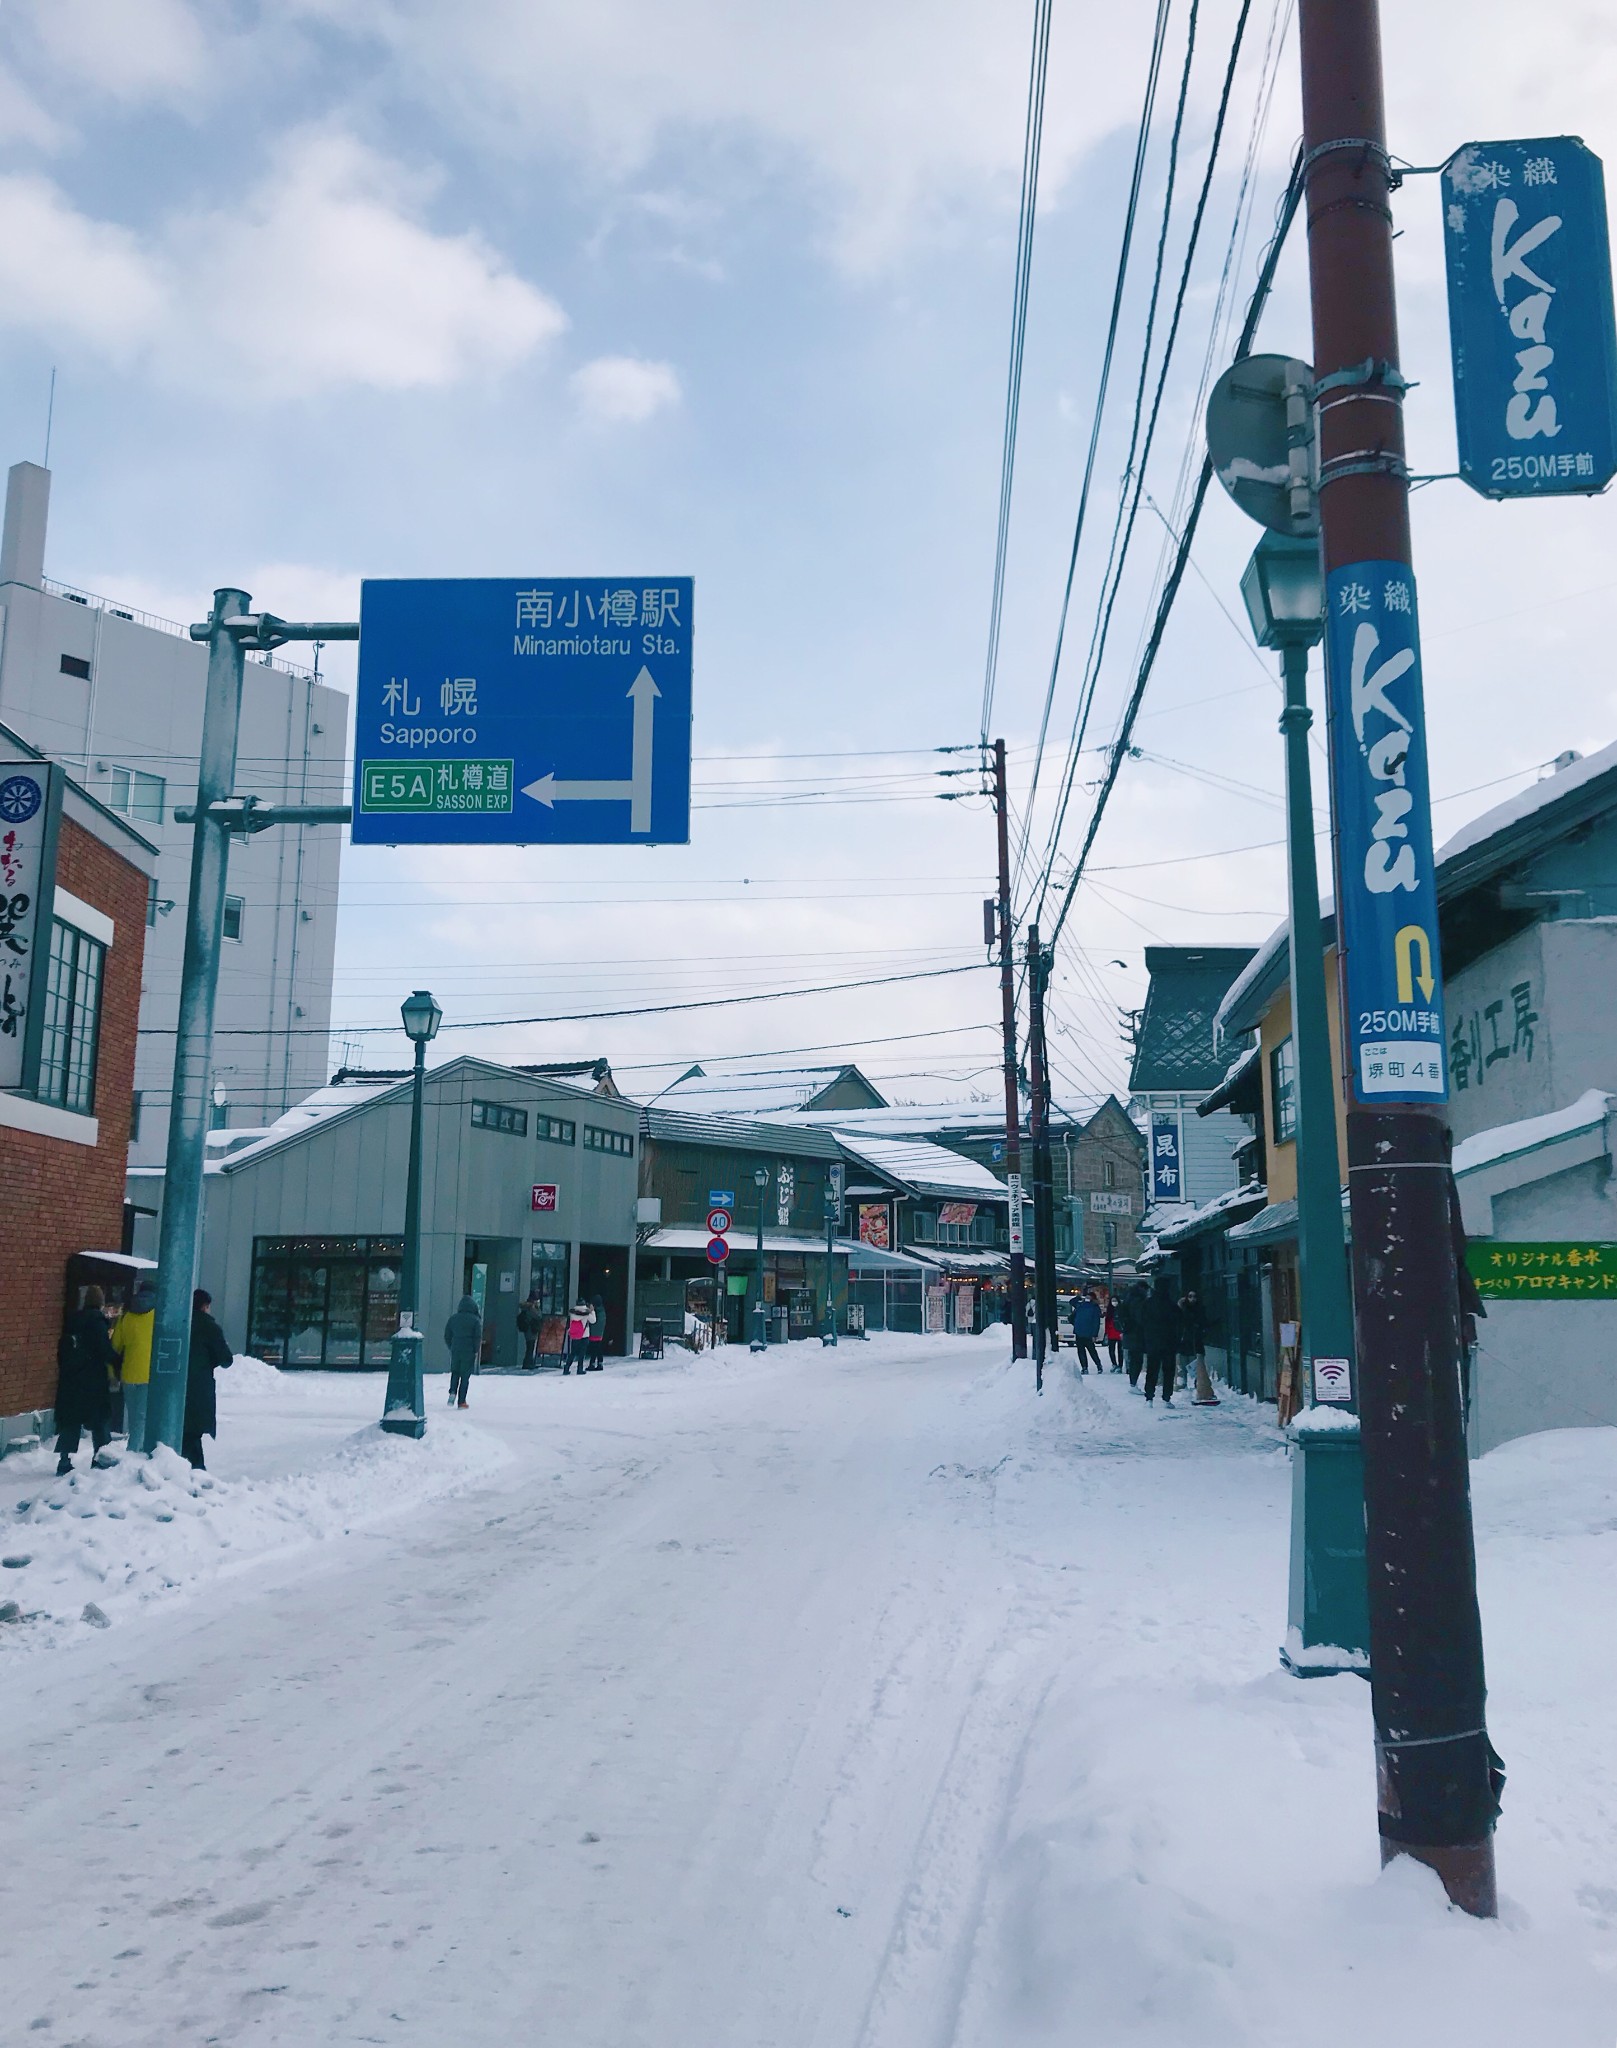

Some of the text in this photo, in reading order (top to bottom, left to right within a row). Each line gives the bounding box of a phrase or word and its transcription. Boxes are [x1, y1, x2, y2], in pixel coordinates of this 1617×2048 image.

[1482, 157, 1558, 189] 染織
[1490, 198, 1562, 440] Kazu
[1490, 452, 1594, 481] 250M手前
[515, 588, 682, 629] 南小樽駅
[1339, 580, 1412, 617] 染織
[513, 634, 680, 656] Minamiotaru Sta.
[381, 677, 478, 717] 札幌
[379, 723, 477, 748] Sapporo
[1350, 621, 1420, 894] Kazu
[370, 775, 428, 798] E5A
[437, 764, 509, 791] 札樽道
[436, 794, 508, 810] SASSON EXP
[1359, 1009, 1440, 1035] 250M手前
[1364, 1047, 1387, 1056] ここは
[1156, 1134, 1179, 1187] 昆布
[712, 1216, 727, 1228] 40
[1490, 1248, 1603, 1267] オリジナル香水
[1473, 1274, 1617, 1290] 手づくりアロマキャンド
